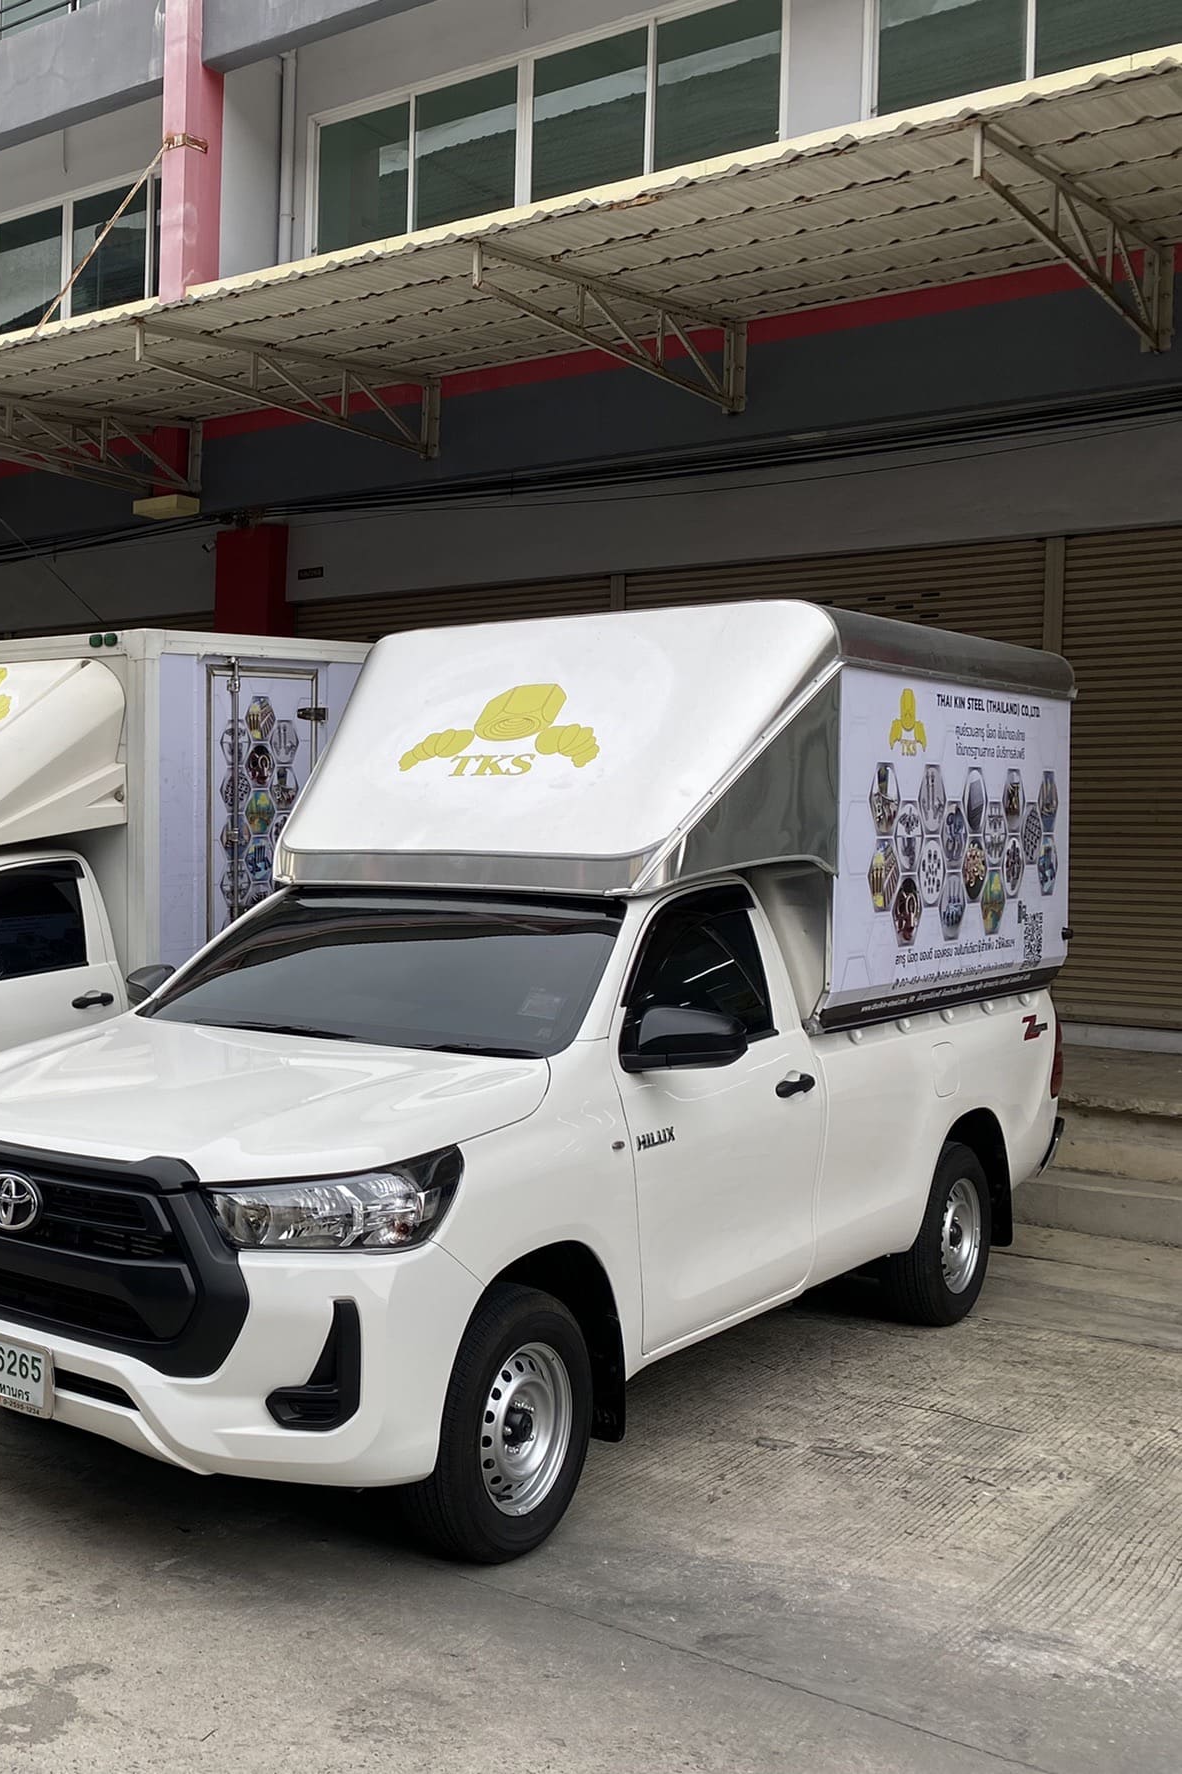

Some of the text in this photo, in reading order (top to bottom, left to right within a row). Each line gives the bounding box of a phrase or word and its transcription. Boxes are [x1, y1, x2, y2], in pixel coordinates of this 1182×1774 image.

[936, 693, 952, 708] THAI
[954, 696, 966, 709] KIN
[967, 697, 986, 712] STEEL
[986, 699, 1020, 716] (THAILAND)
[901, 739, 917, 757] TKS
[448, 753, 536, 778] TKS
[636, 1126, 676, 1152] HILUX
